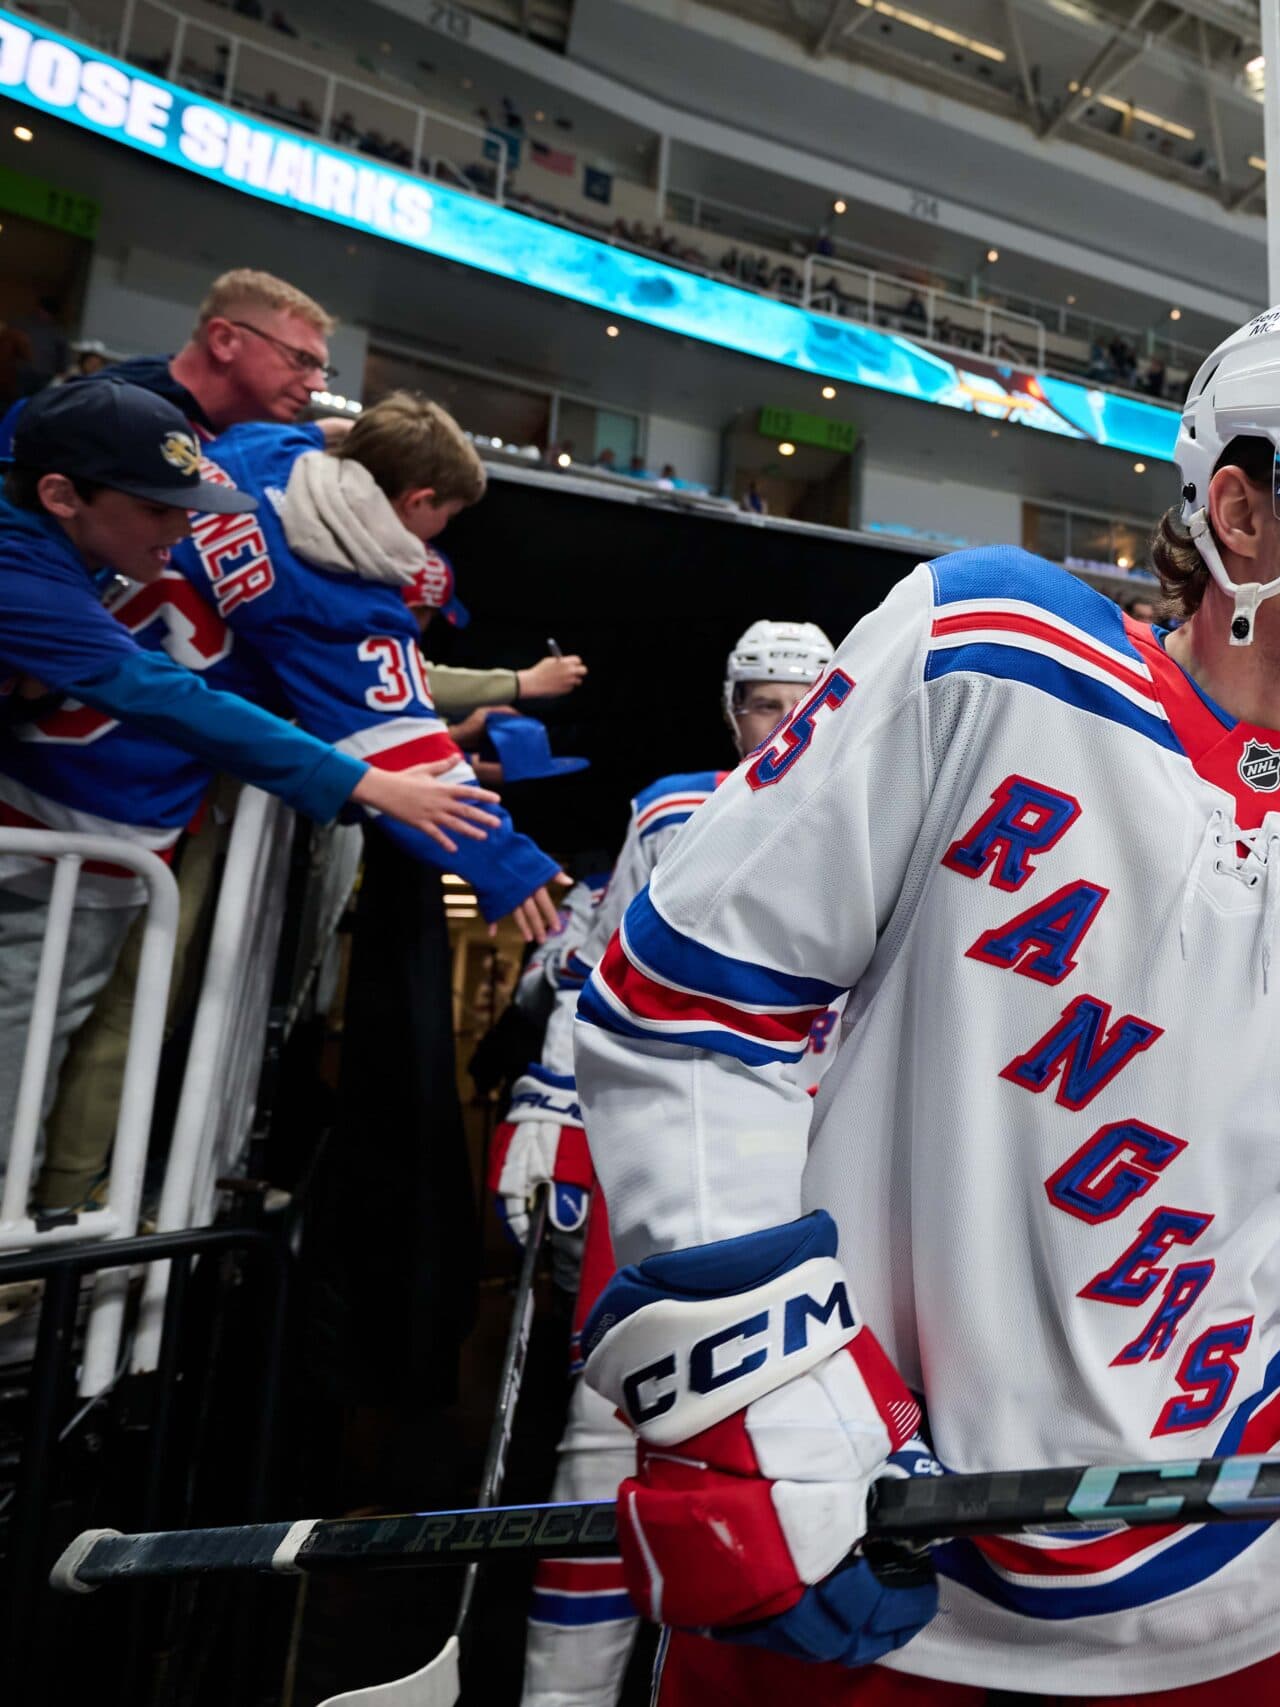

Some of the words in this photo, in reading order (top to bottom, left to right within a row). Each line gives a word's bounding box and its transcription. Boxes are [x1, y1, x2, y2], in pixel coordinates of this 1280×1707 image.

[0, 17, 173, 149] JOSE
[179, 104, 433, 239] SHARKS
[769, 650, 809, 659] CCM
[740, 667, 857, 792] 5
[1246, 759, 1276, 777] NHL
[940, 773, 1255, 1439] RANGERS
[622, 1281, 856, 1426] CCM
[913, 1458, 945, 1477] CC
